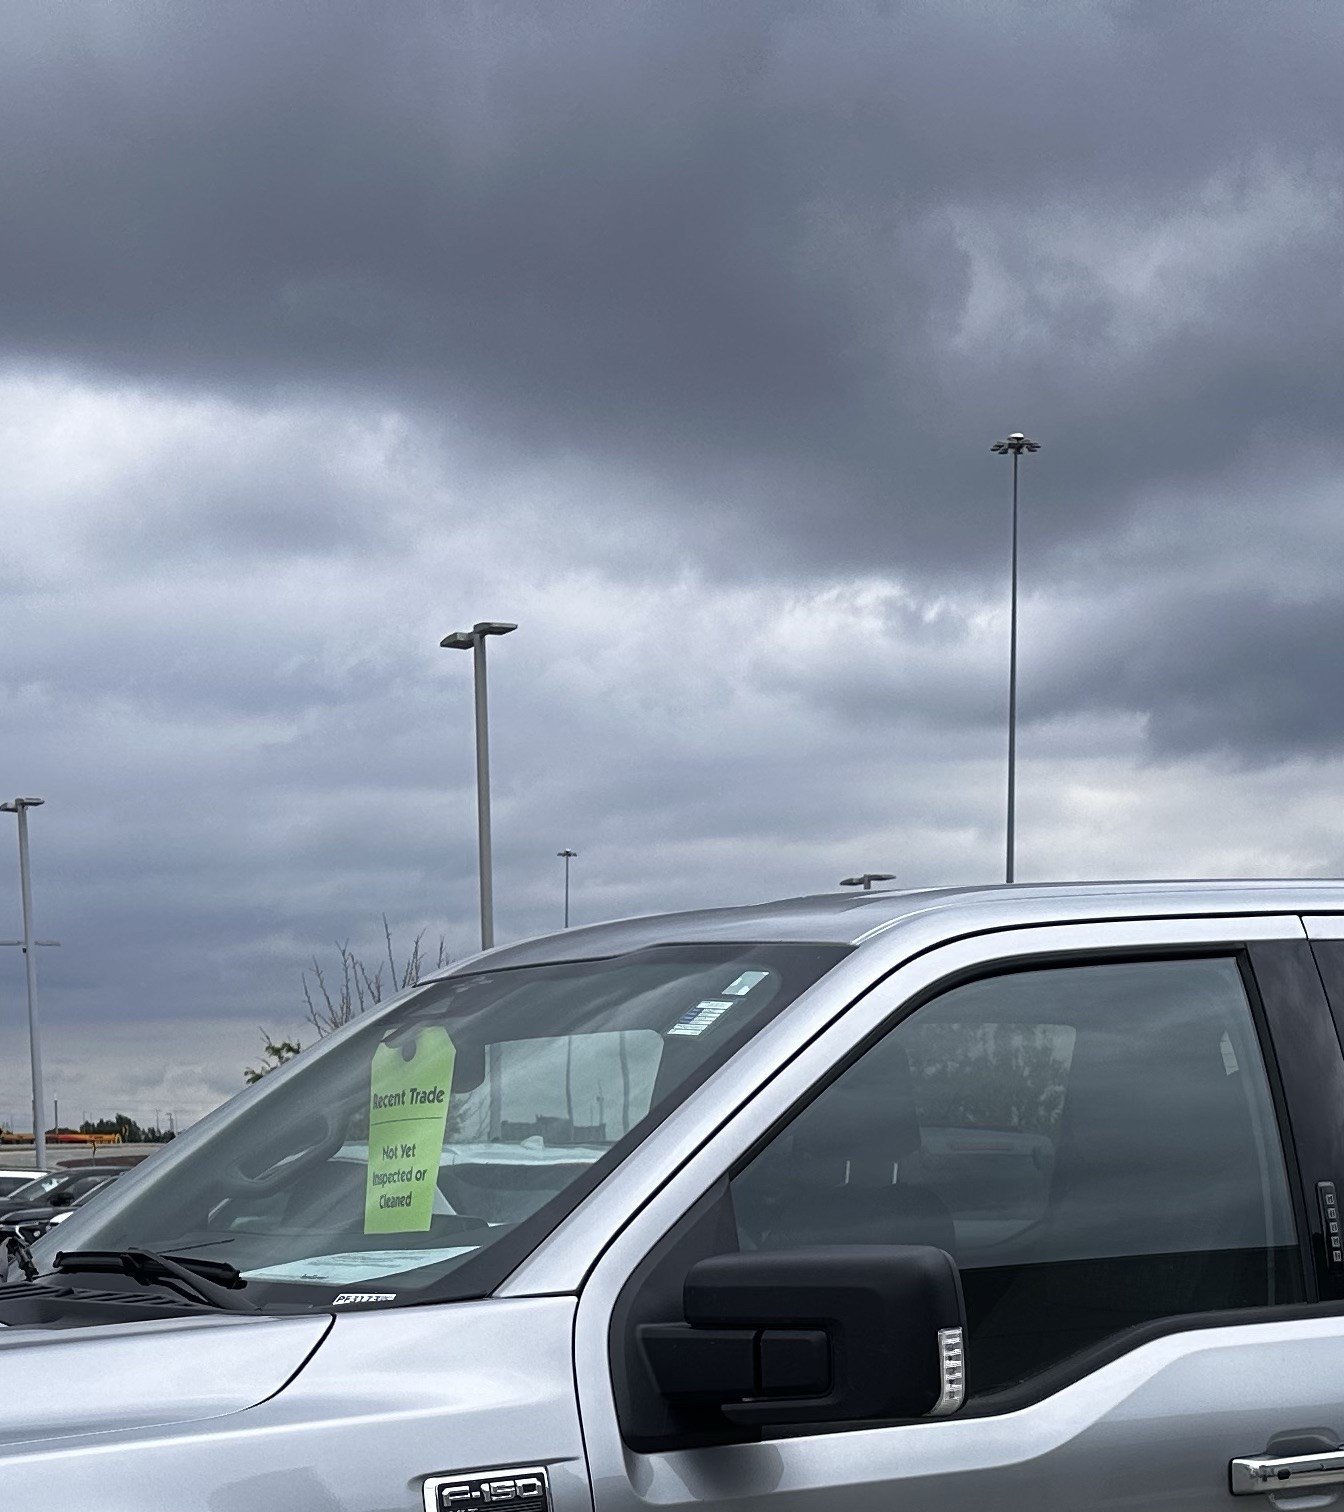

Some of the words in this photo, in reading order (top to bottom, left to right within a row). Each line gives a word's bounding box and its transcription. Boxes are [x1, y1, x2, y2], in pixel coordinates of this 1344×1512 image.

[373, 1089, 405, 1110] Recent
[409, 1086, 445, 1105] Trade
[382, 1146, 398, 1160] Not
[400, 1143, 416, 1158] Yet
[373, 1166, 413, 1188] Inspected
[415, 1168, 427, 1182] or
[379, 1191, 412, 1209] Cleaned
[442, 1478, 543, 1507] F-150
